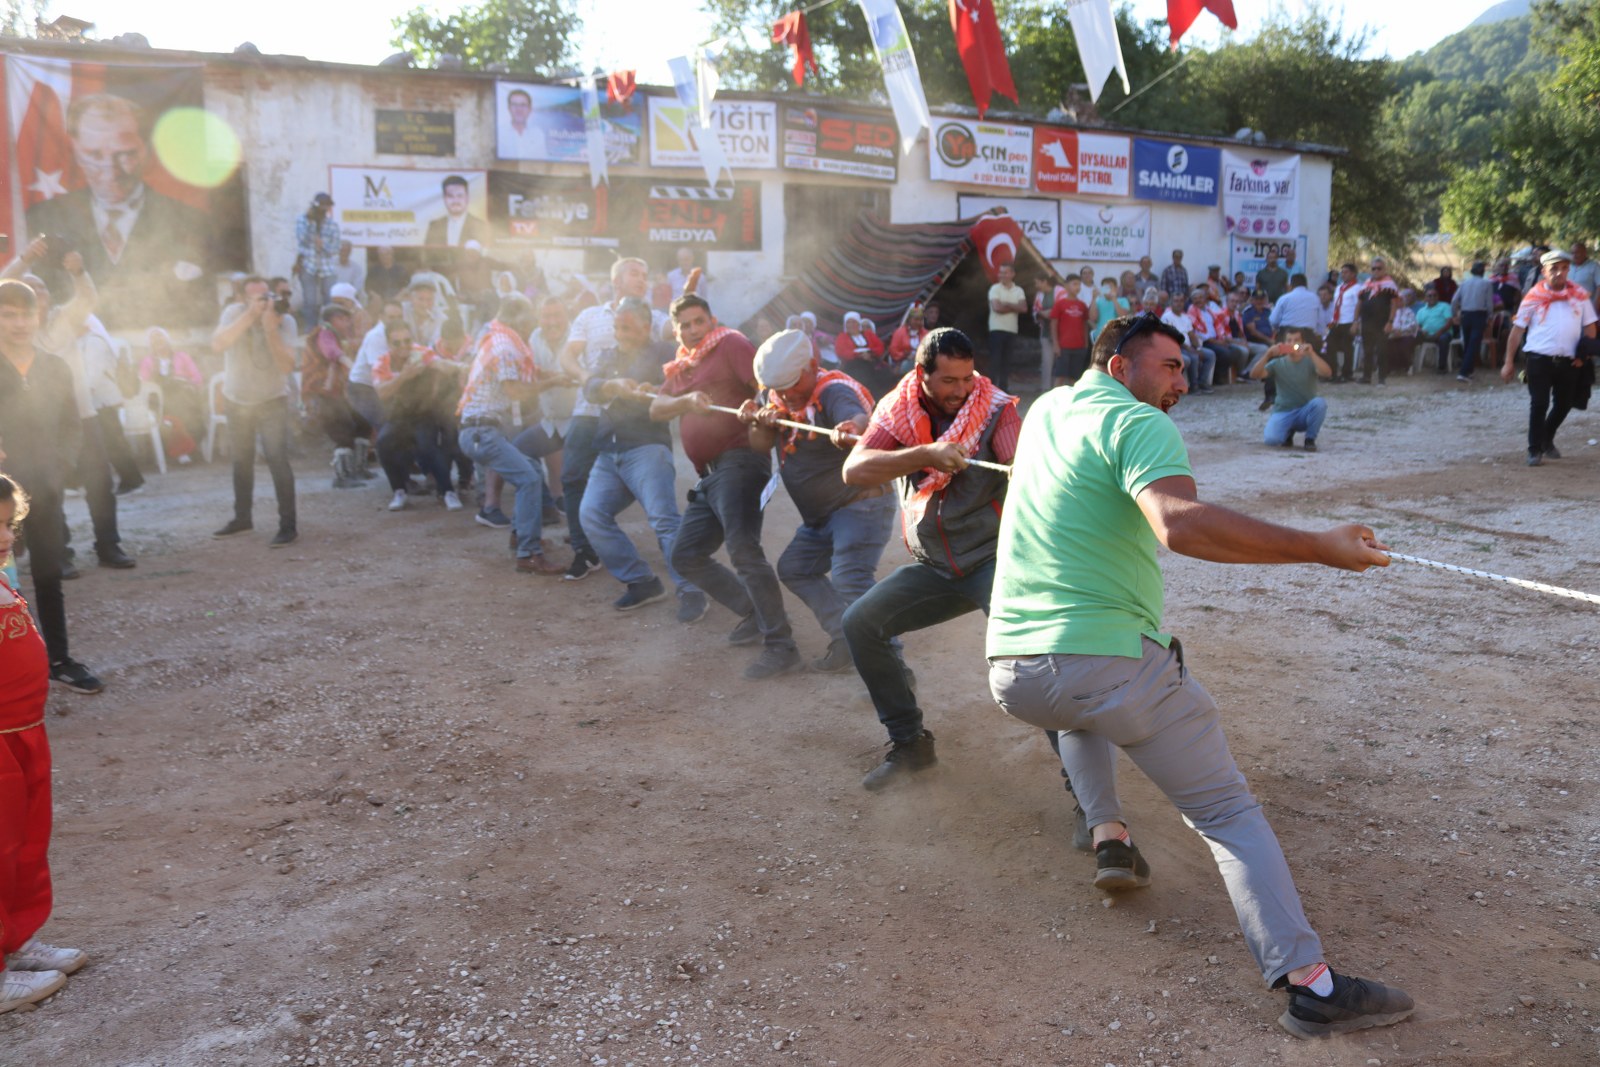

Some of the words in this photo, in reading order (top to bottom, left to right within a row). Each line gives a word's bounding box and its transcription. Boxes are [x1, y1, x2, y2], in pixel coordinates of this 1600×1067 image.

[1080, 152, 1127, 170] UYSALLAR
[1080, 170, 1113, 185] PETROL
[1274, 180, 1291, 195] var
[508, 193, 589, 224] Fethiye
[514, 221, 534, 233] TV
[1067, 224, 1145, 238] ÇOBANOĞLU
[648, 228, 717, 242] MEDYA
[1088, 236, 1124, 247] TARIM
